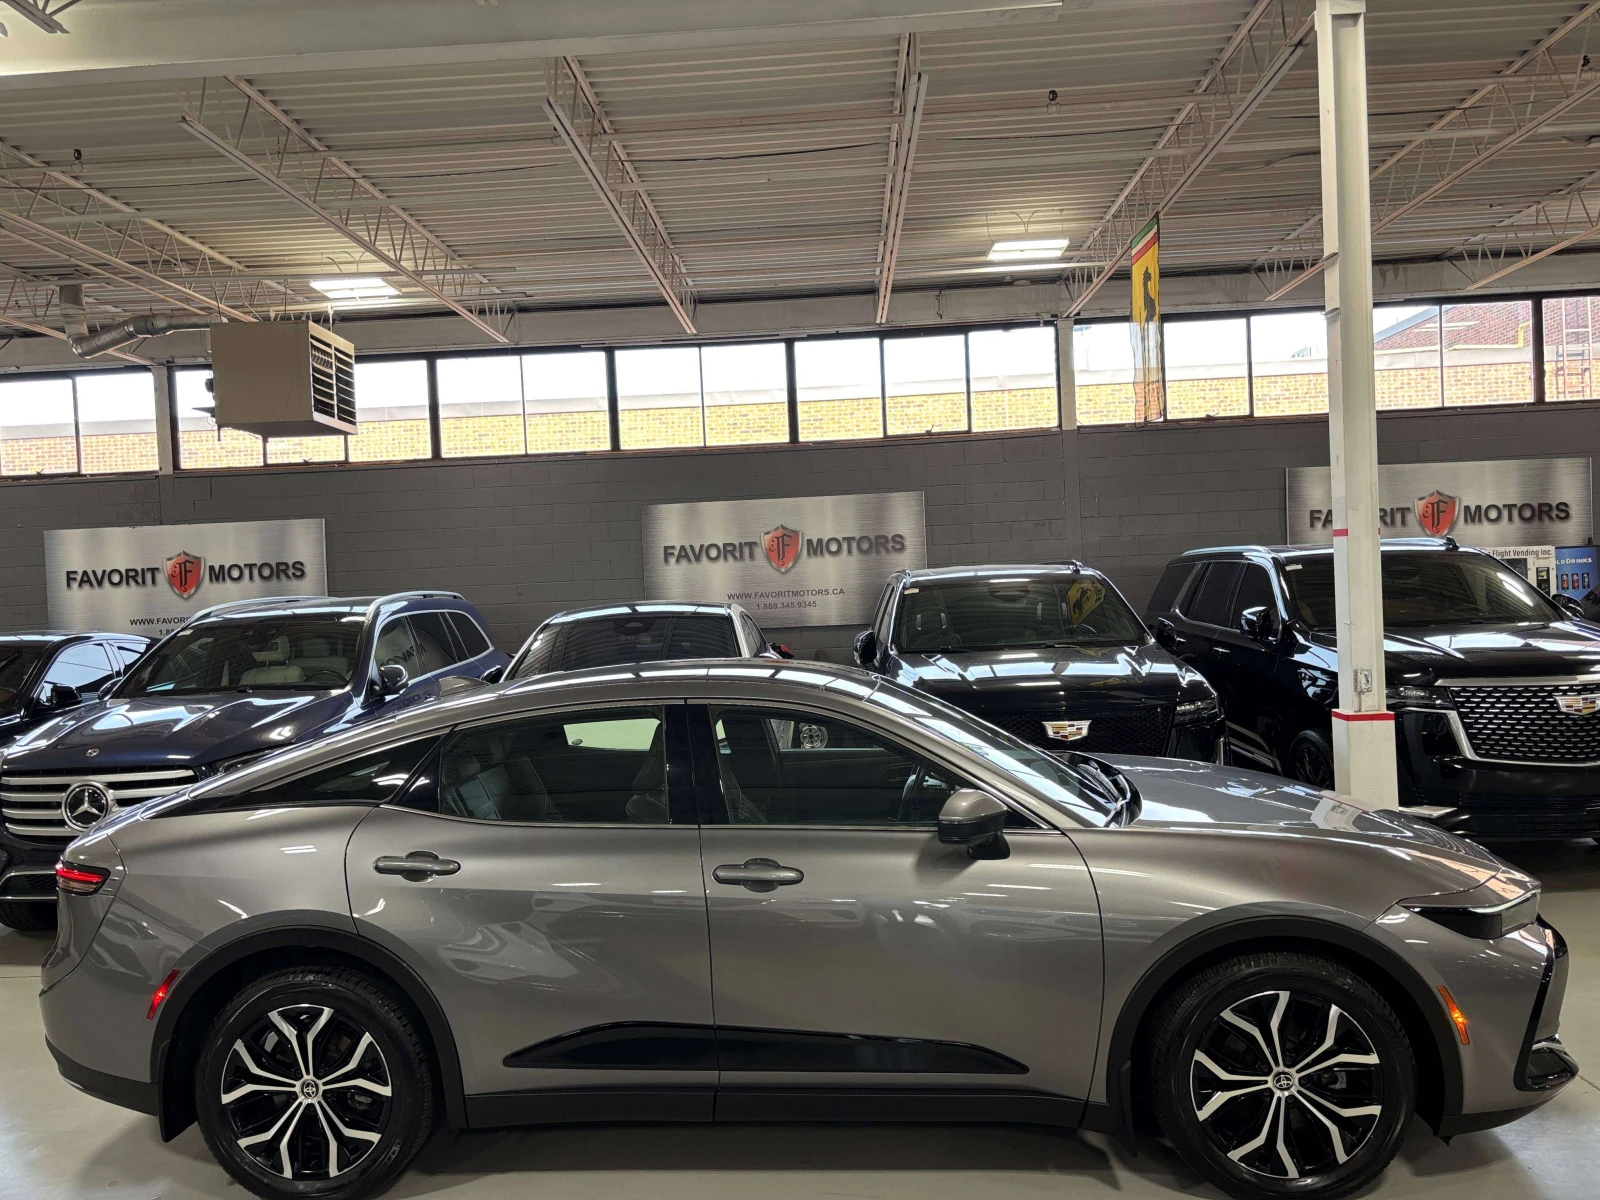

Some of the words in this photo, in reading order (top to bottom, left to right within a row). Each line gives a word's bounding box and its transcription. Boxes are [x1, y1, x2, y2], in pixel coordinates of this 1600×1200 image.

[1309, 507, 1411, 529] FARIT
[1464, 501, 1571, 524] MOTORS
[663, 541, 759, 564] FAVORIT
[806, 533, 906, 557] MOTORS
[1492, 549, 1511, 558] Flight
[1512, 548, 1540, 558] Vending
[1541, 548, 1553, 556] Inc.
[1565, 557, 1593, 565] DRINKS
[65, 566, 160, 588] FAVORIT
[208, 560, 306, 583] MOTORS
[726, 587, 846, 601] WWW.FAVORITMOTORS.CA
[755, 600, 818, 611] 1.888.345.9345
